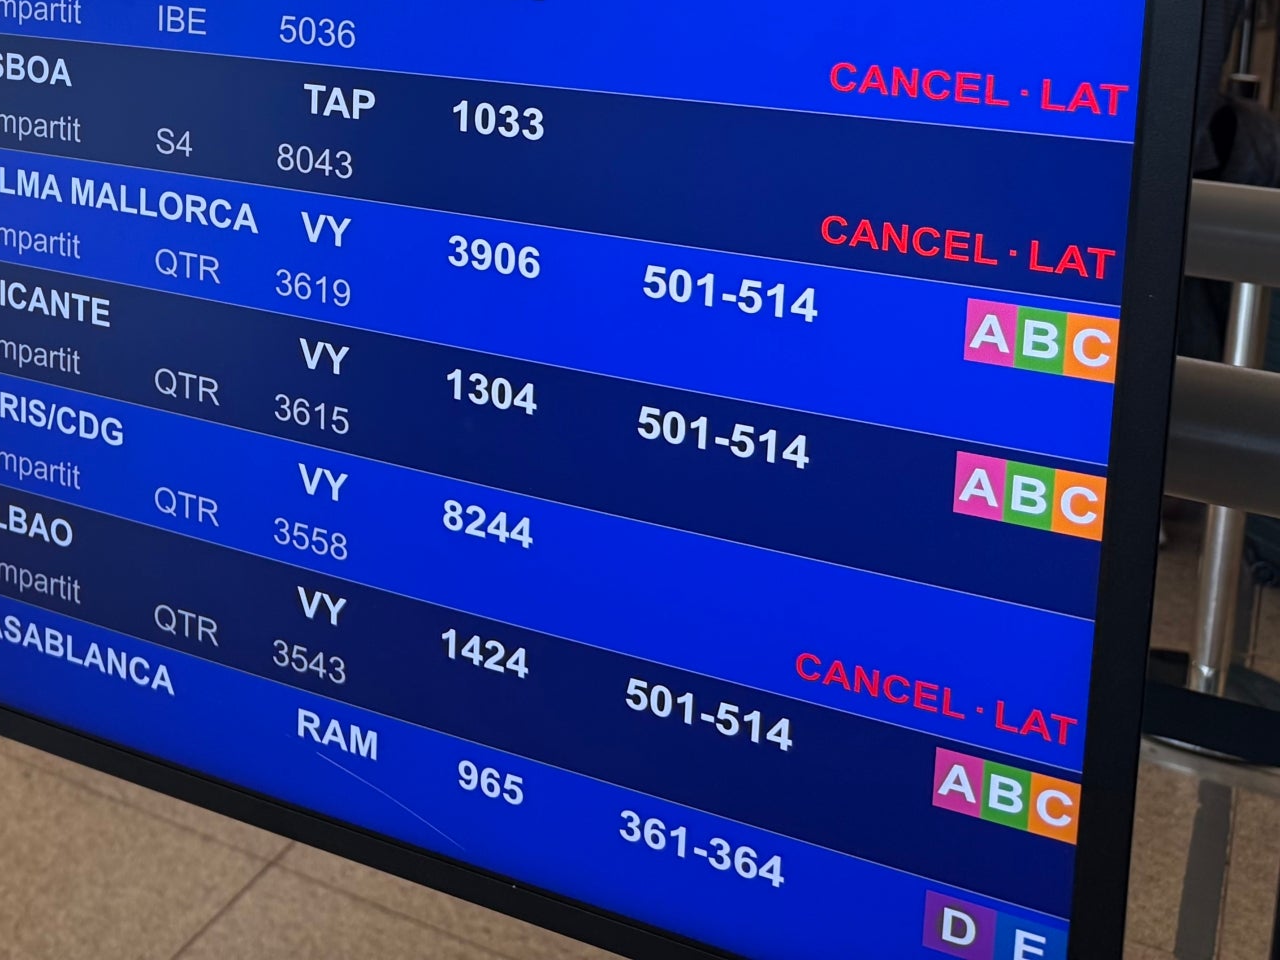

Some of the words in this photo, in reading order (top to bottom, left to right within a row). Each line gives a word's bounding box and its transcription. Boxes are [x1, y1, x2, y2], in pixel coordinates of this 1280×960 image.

[158, 5, 207, 35] IBE
[279, 15, 356, 49] 5036
[303, 83, 376, 120] TAP
[452, 100, 544, 141] 1033
[156, 127, 193, 157] S4
[277, 143, 353, 179] 8043
[71, 176, 259, 234] MALLORCA
[300, 211, 352, 247] VY
[448, 235, 540, 279] 3906
[643, 264, 818, 323] 501-514
[155, 248, 220, 284] QTR
[275, 268, 351, 307] 3619
[154, 368, 220, 406] QTR
[274, 393, 349, 435] 3615
[299, 337, 350, 375] VY
[446, 368, 537, 415] 1304
[637, 405, 810, 469] 501-514
[154, 487, 219, 527] QTR
[274, 517, 348, 560] 3558
[298, 462, 348, 502] VY
[443, 499, 533, 549] 8244
[154, 604, 219, 646] QTR
[272, 639, 346, 684] 3543
[297, 585, 347, 626] VY
[441, 628, 529, 679] 1424
[625, 677, 793, 752] 501-514
[297, 708, 378, 761] RAM
[458, 760, 524, 805] 965
[619, 810, 785, 888] 361-364
[941, 906, 977, 946] D
